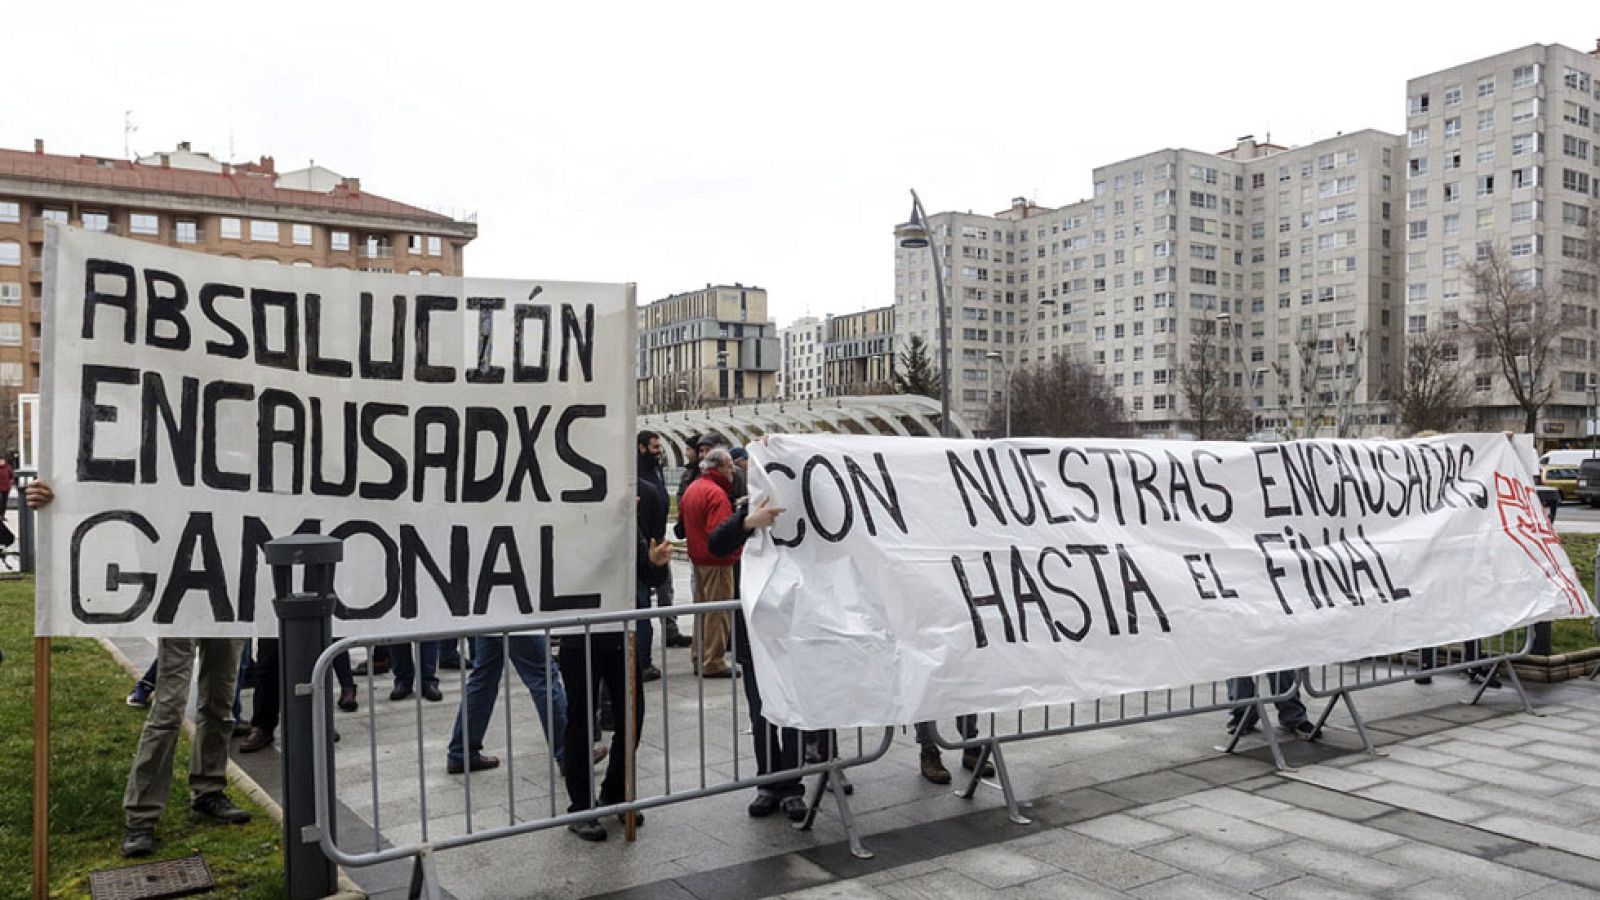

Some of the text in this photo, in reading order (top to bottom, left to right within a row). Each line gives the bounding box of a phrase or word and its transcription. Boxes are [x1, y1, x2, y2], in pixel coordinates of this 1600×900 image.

[81, 258, 594, 384] ABSOLUCIÓN
[76, 364, 608, 503] ENCAUSADXS
[765, 443, 1488, 547] CON NUESTRAS ENCAUSADAS
[71, 510, 602, 625] GAMONAL
[951, 544, 1171, 648] HASTA
[1183, 552, 1238, 599] EL
